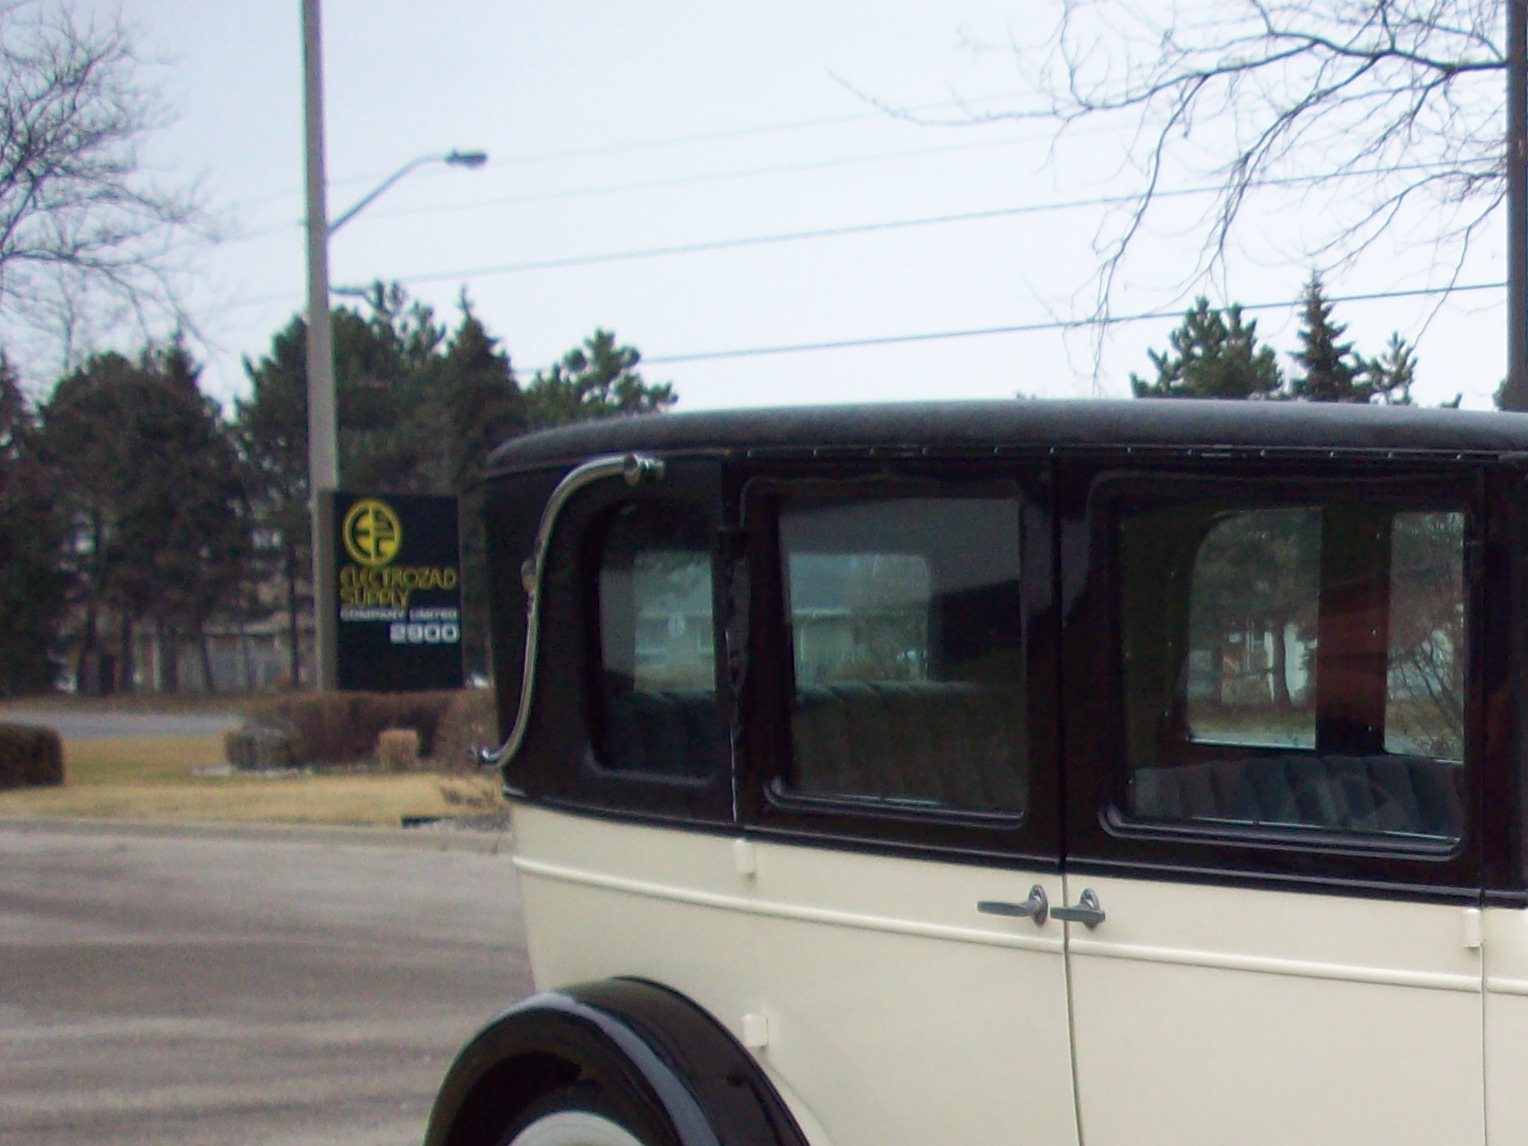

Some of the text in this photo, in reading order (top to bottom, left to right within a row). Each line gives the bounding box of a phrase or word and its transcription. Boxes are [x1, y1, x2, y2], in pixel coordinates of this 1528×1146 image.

[341, 566, 457, 590] ELECTROZAD
[341, 587, 409, 608] SUPPLY
[340, 607, 458, 621] COMPANY LIMITED
